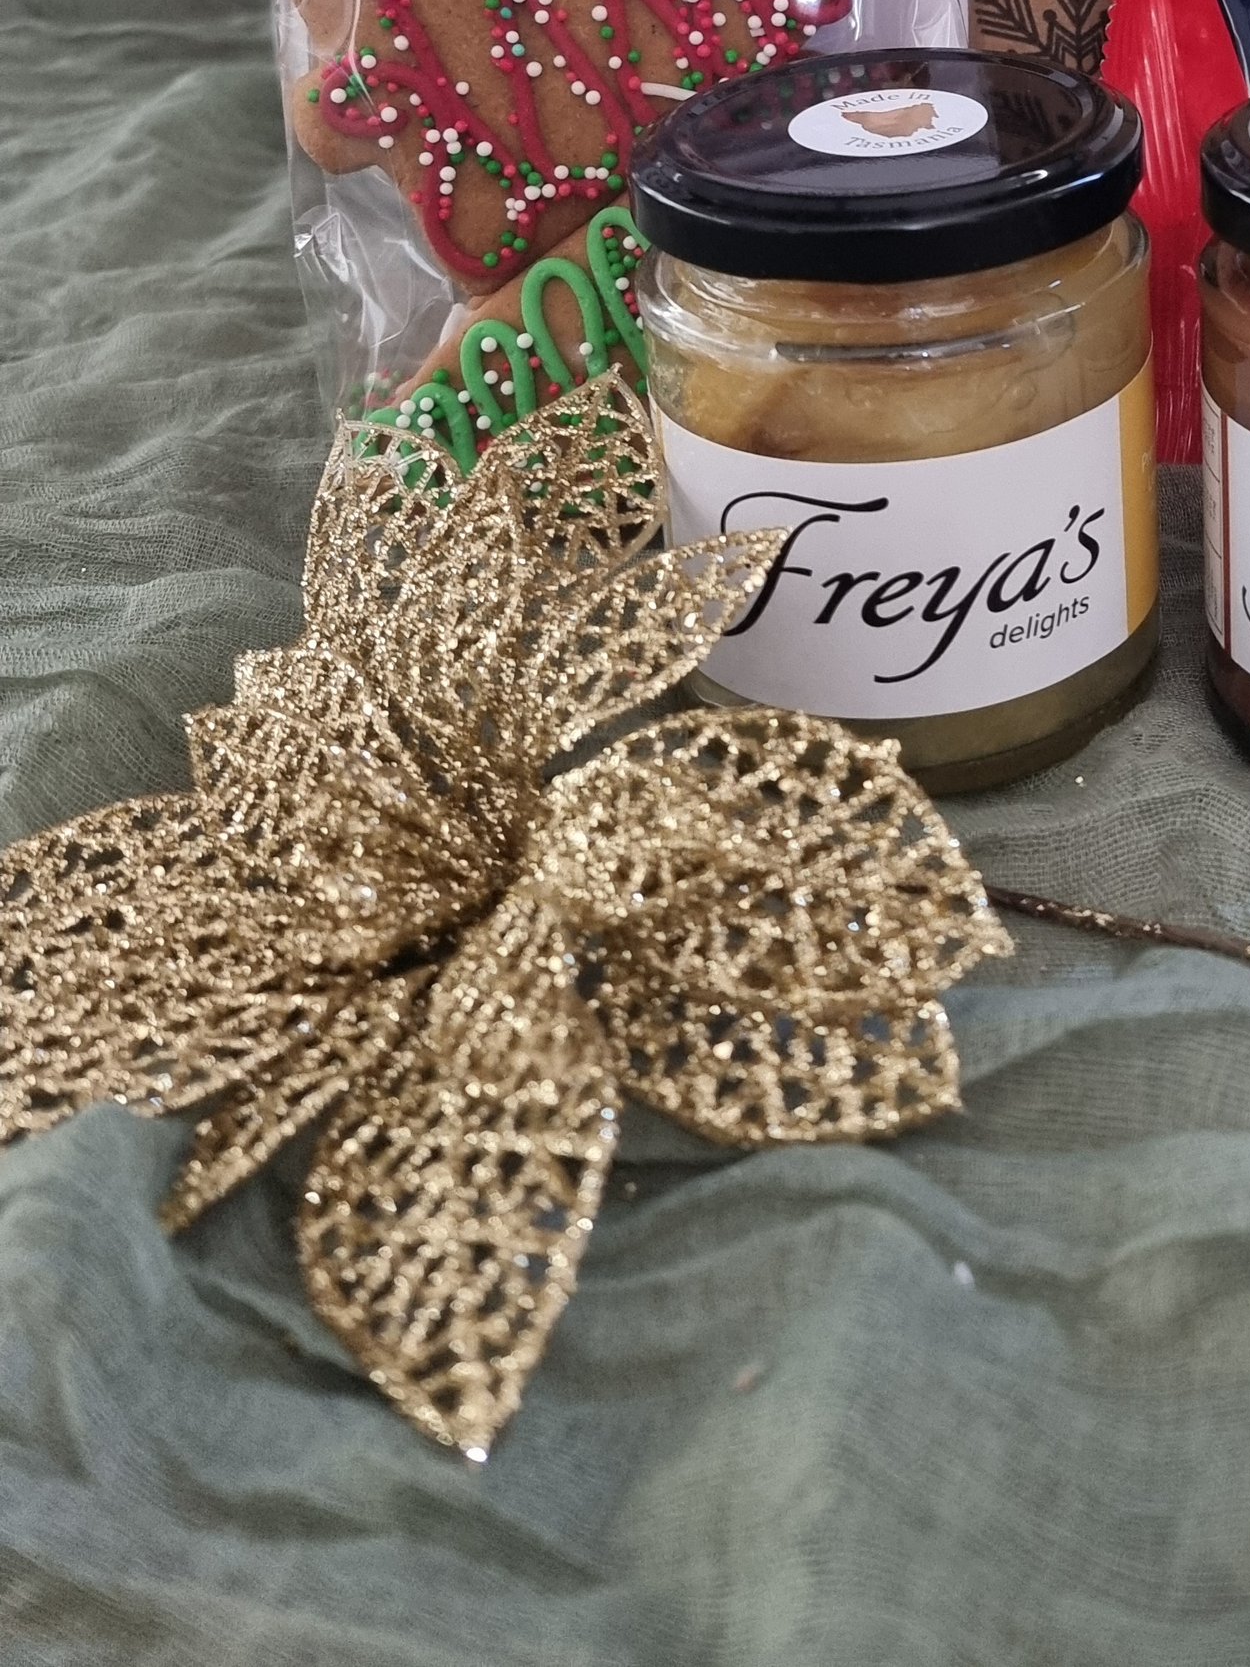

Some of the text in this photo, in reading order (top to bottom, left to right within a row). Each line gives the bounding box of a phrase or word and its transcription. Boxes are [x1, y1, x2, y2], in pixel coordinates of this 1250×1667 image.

[830, 91, 931, 111] Made in
[844, 124, 964, 150] Tasmania
[721, 491, 1105, 684] Freya's
[990, 592, 1090, 649] delights
